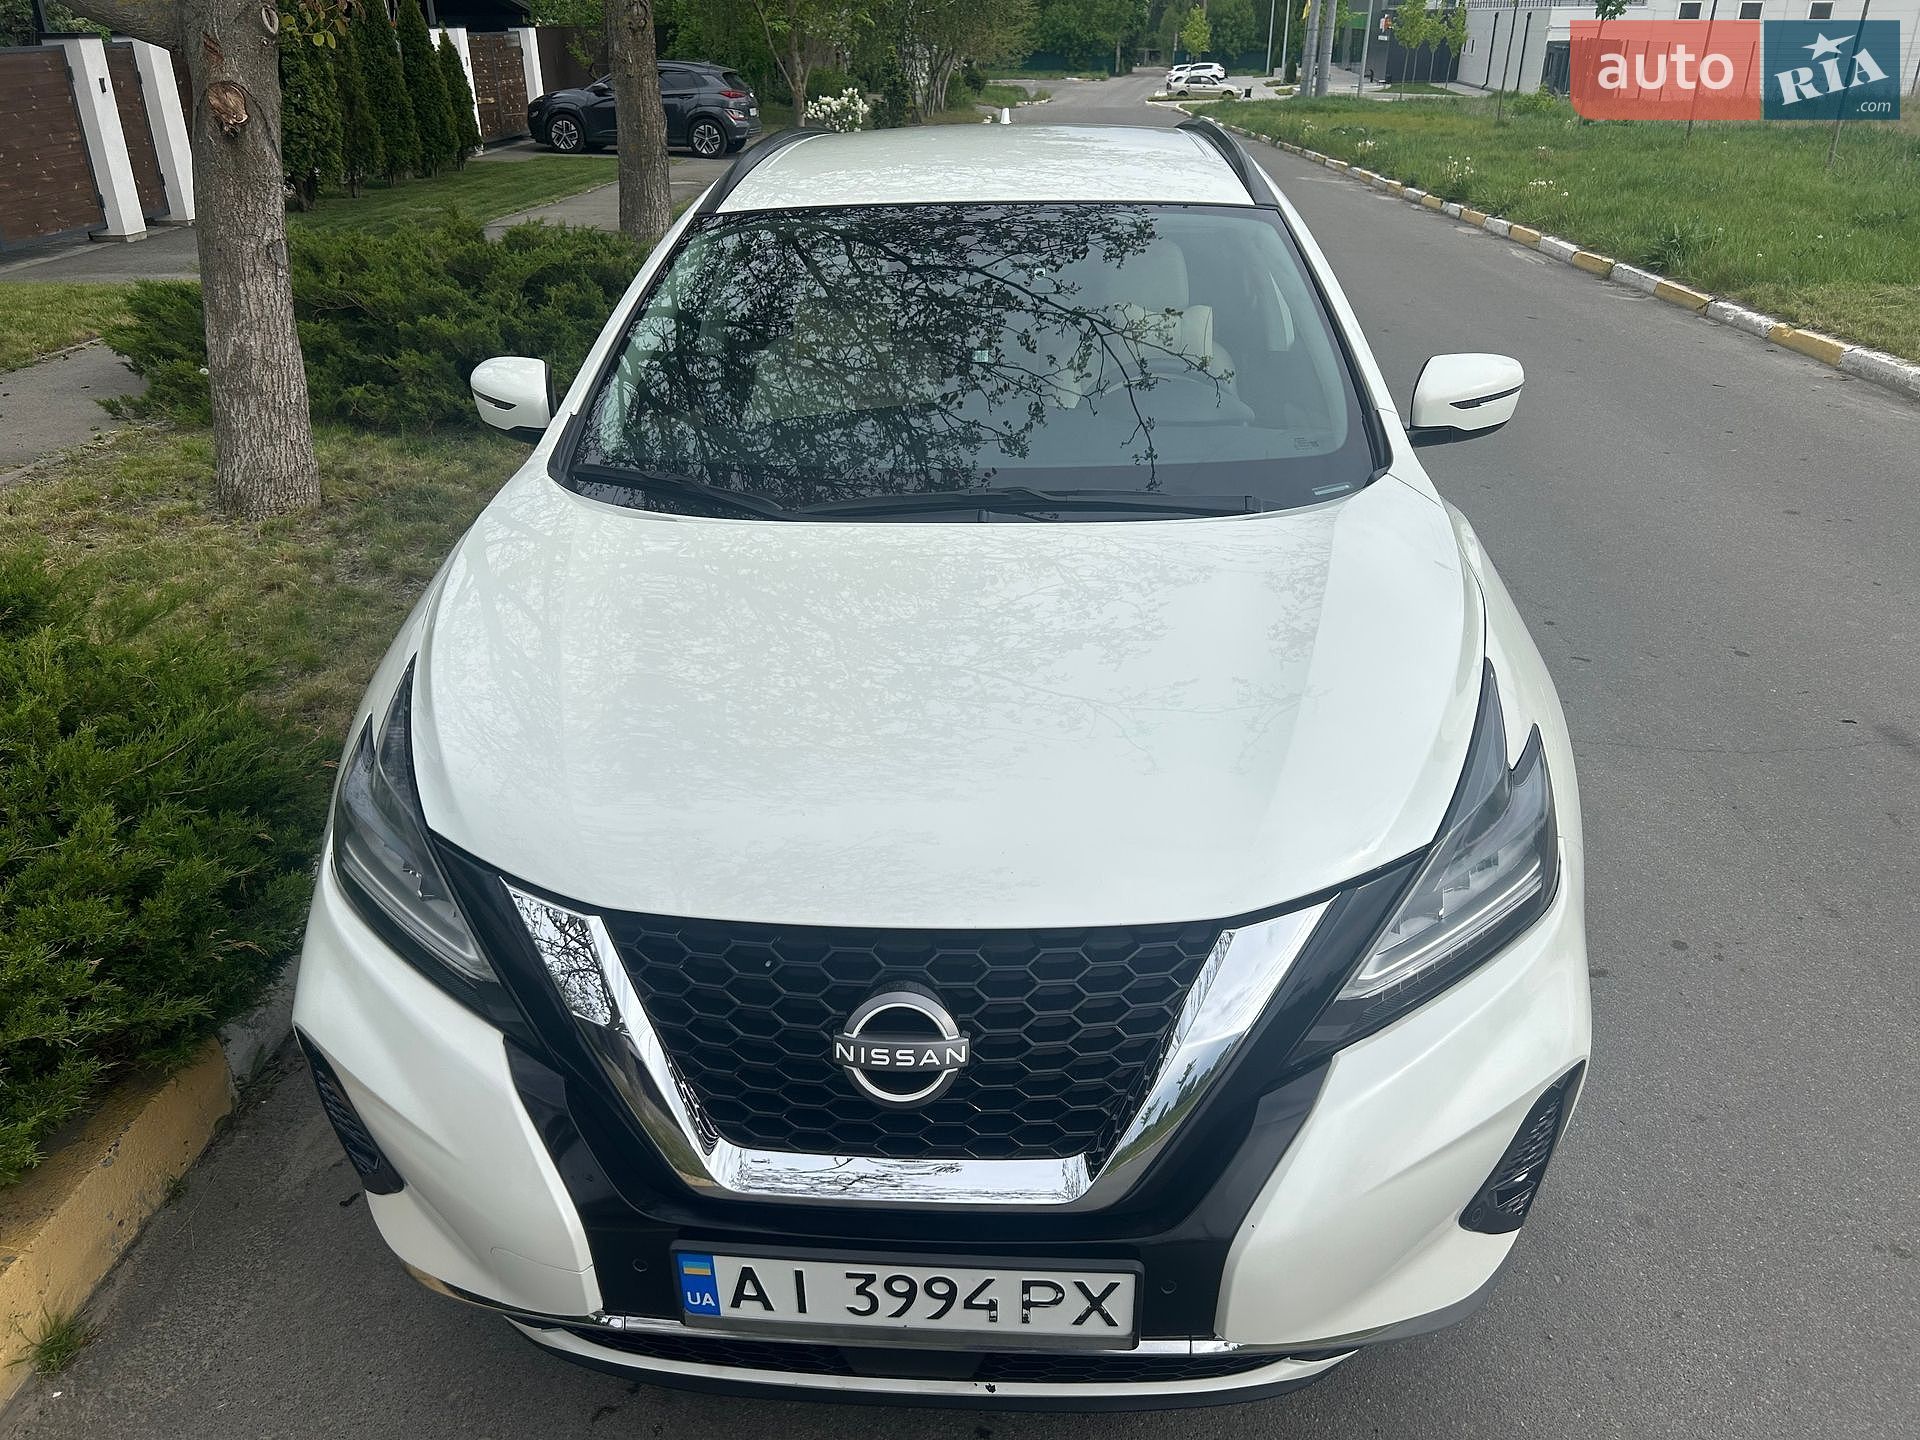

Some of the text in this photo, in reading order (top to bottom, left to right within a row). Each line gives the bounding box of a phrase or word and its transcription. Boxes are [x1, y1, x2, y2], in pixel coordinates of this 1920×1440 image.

[835, 1042, 967, 1067] NISSAN
[687, 1291, 716, 1307] UA
[730, 1265, 1122, 1327] AI 3994 PX
